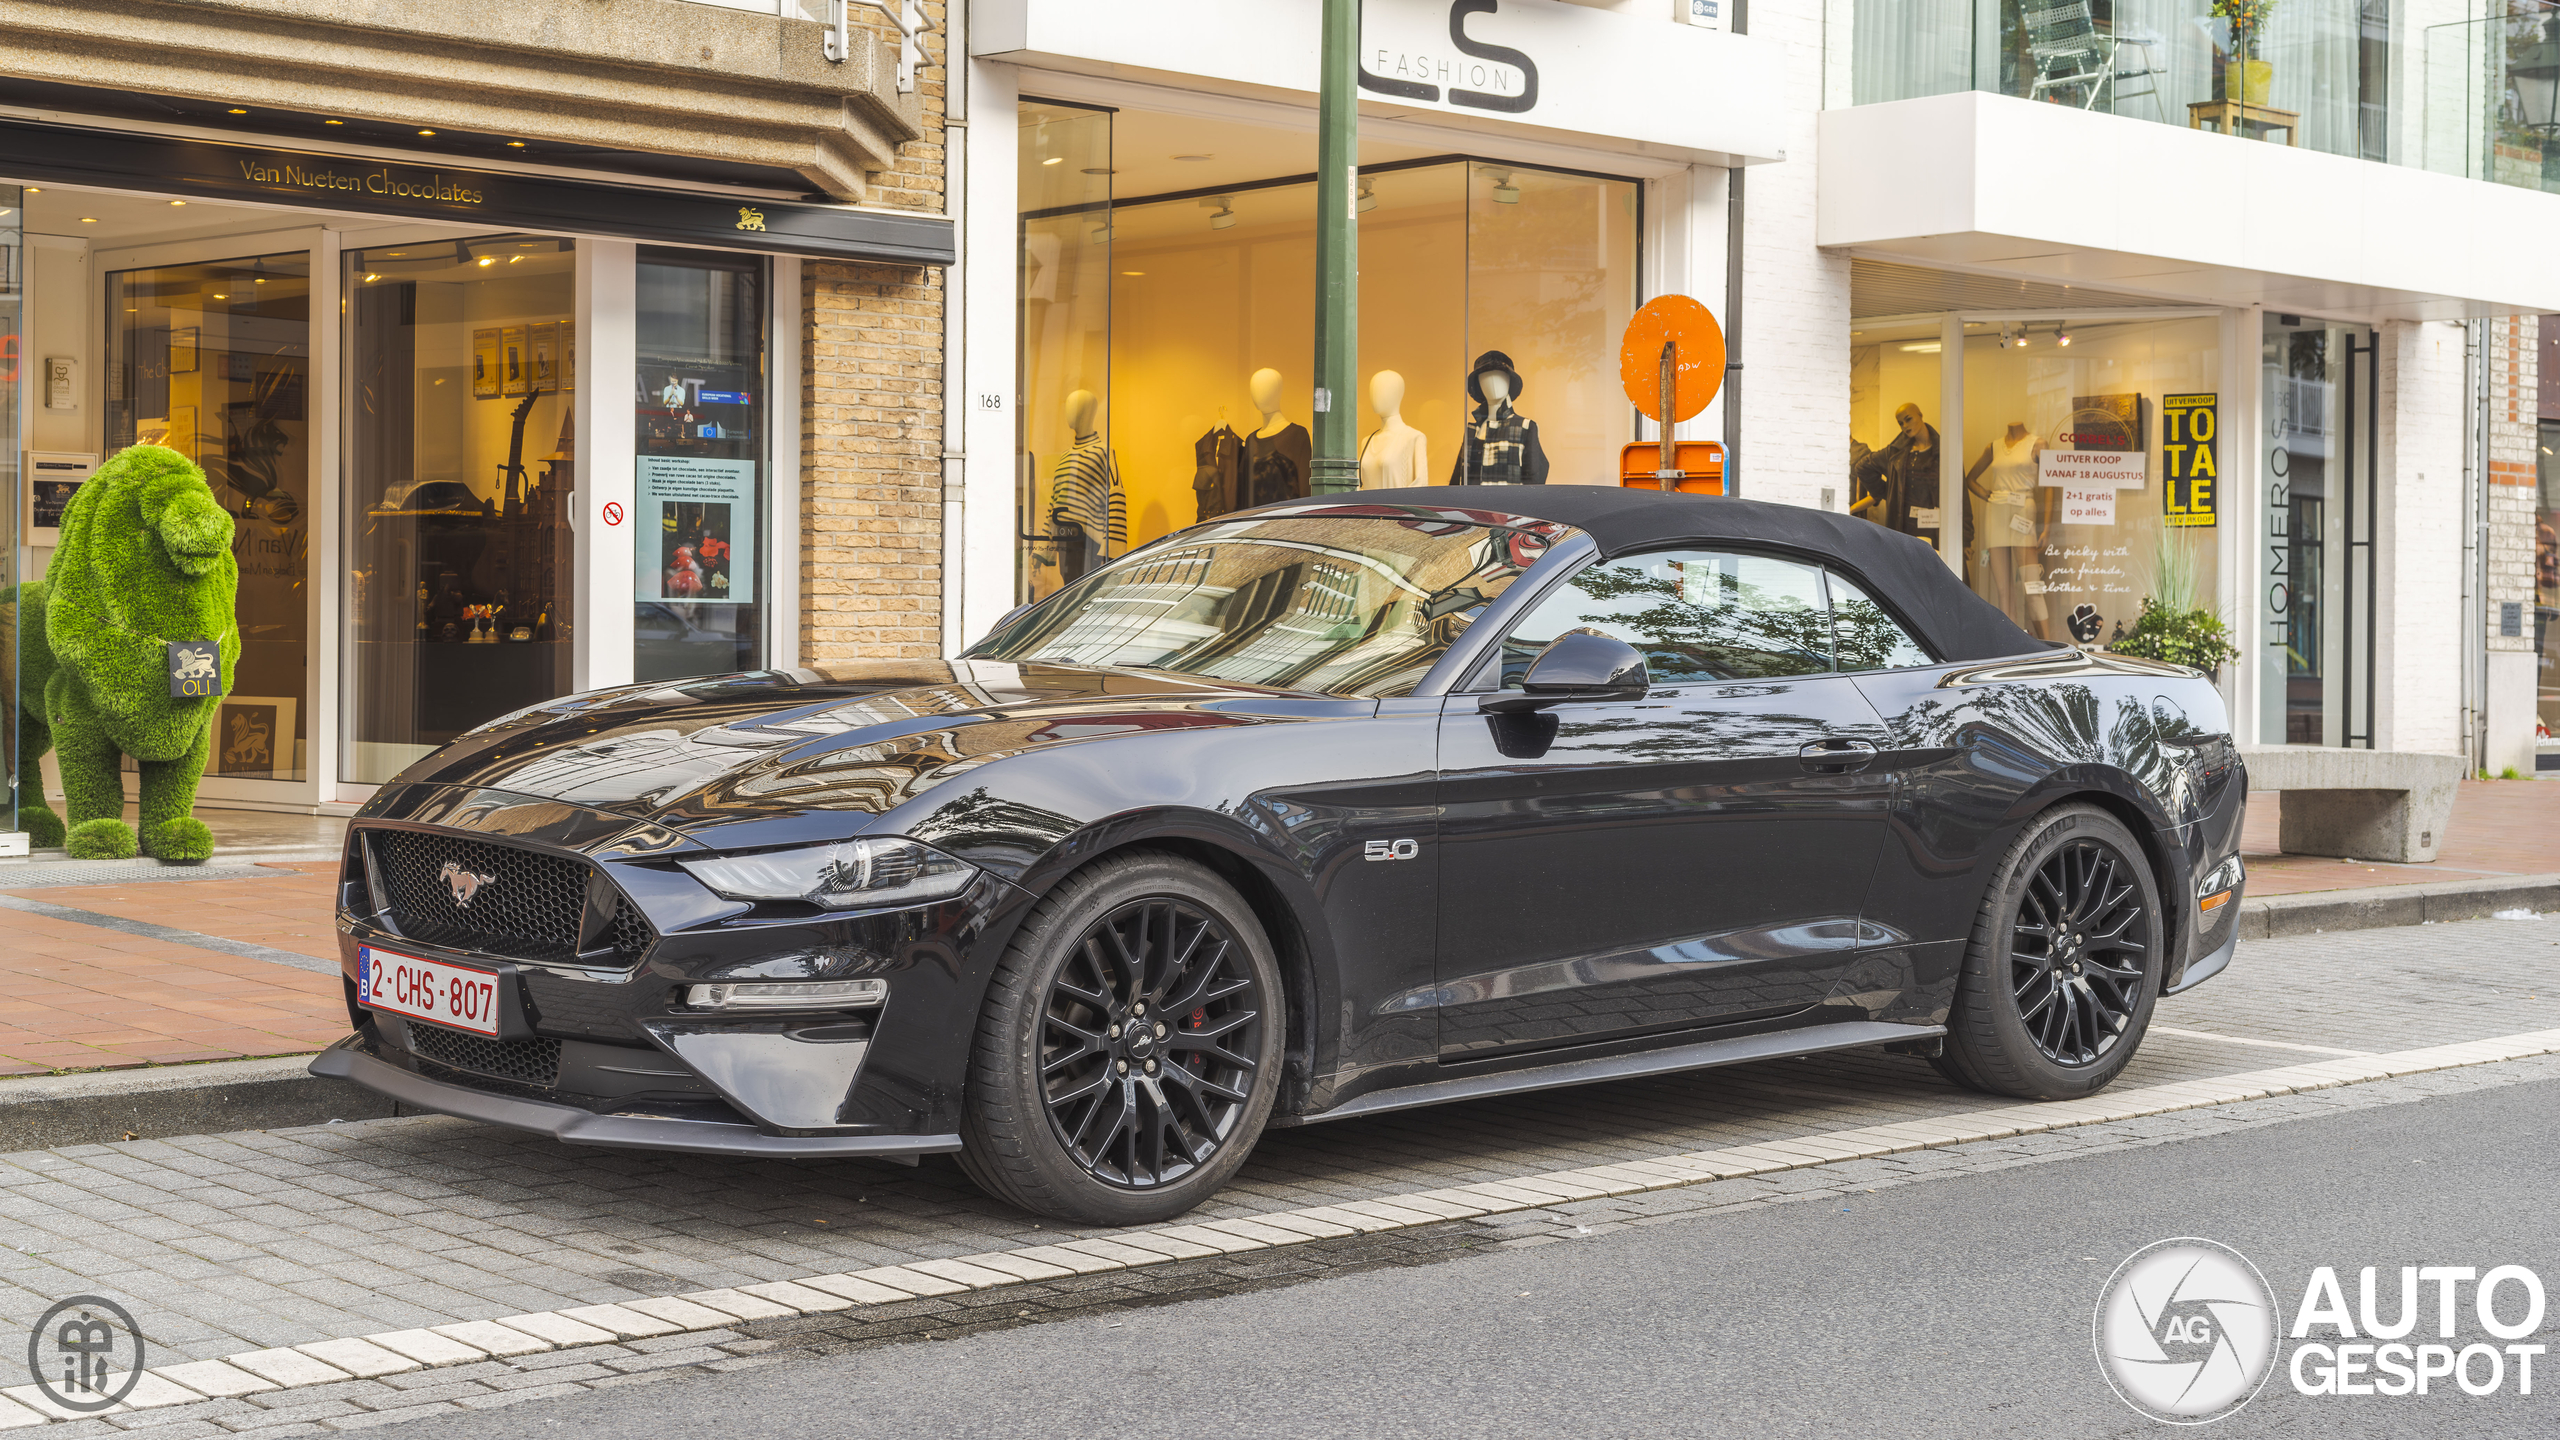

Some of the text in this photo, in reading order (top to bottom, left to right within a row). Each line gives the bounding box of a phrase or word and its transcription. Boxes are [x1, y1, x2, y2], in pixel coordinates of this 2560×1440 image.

[1377, 50, 1508, 90] FASHION
[240, 160, 483, 203] Van Nueten Chocolates
[1678, 361, 1701, 372] ADW
[981, 394, 1001, 408] 168
[2167, 396, 2213, 405] UITVERKOOP
[2164, 407, 2215, 442] TO
[2059, 432, 2126, 446] CORBEL'S
[2056, 454, 2122, 465] UITVER KOOP
[2164, 444, 2216, 477] TA
[2045, 469, 2144, 480] VANAF 18 AUGUSTUS
[2066, 491, 2113, 502] 2+1 gratis
[2167, 479, 2211, 512] LE
[2070, 507, 2107, 517] op alles
[1018, 505, 1084, 541] LS
[2270, 418, 2290, 646] HOMEROS
[2045, 544, 2129, 561] Be picky with
[2077, 562, 2125, 580] friends,
[2042, 581, 2083, 592] clothes
[2103, 582, 2131, 592] time
[182, 679, 210, 696] OLI
[1364, 838, 1419, 862] 5.0
[2020, 816, 2074, 874] MICHELIN
[1032, 953, 1049, 986] PILOT
[1048, 920, 1073, 953] SPORT
[360, 978, 369, 996] B
[372, 959, 493, 1023] 2-CHS-807
